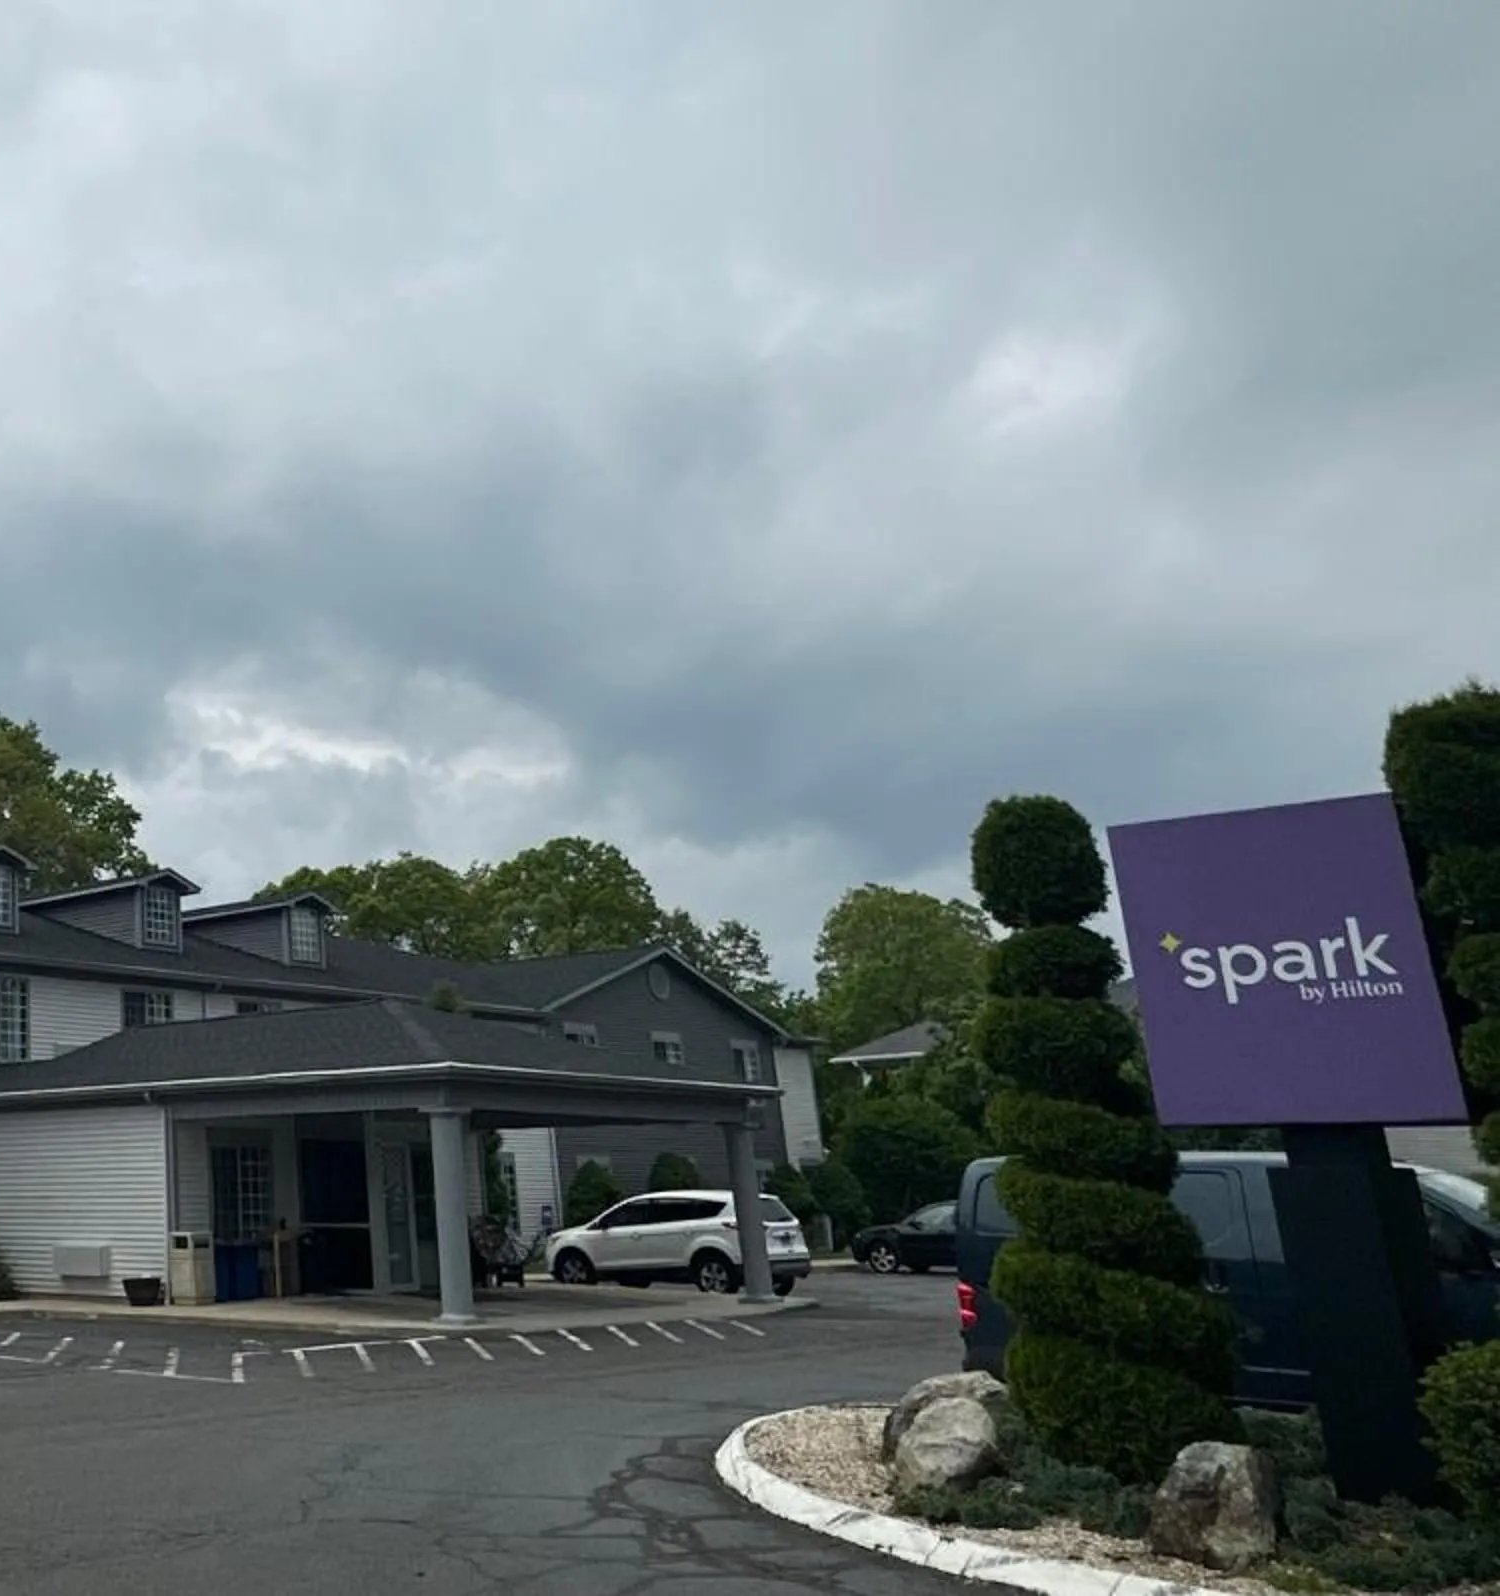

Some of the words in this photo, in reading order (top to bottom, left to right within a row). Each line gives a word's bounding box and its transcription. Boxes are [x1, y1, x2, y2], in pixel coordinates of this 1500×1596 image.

[1180, 916, 1398, 1005] spark
[1300, 982, 1325, 1004] by
[1329, 979, 1404, 999] Hilton
